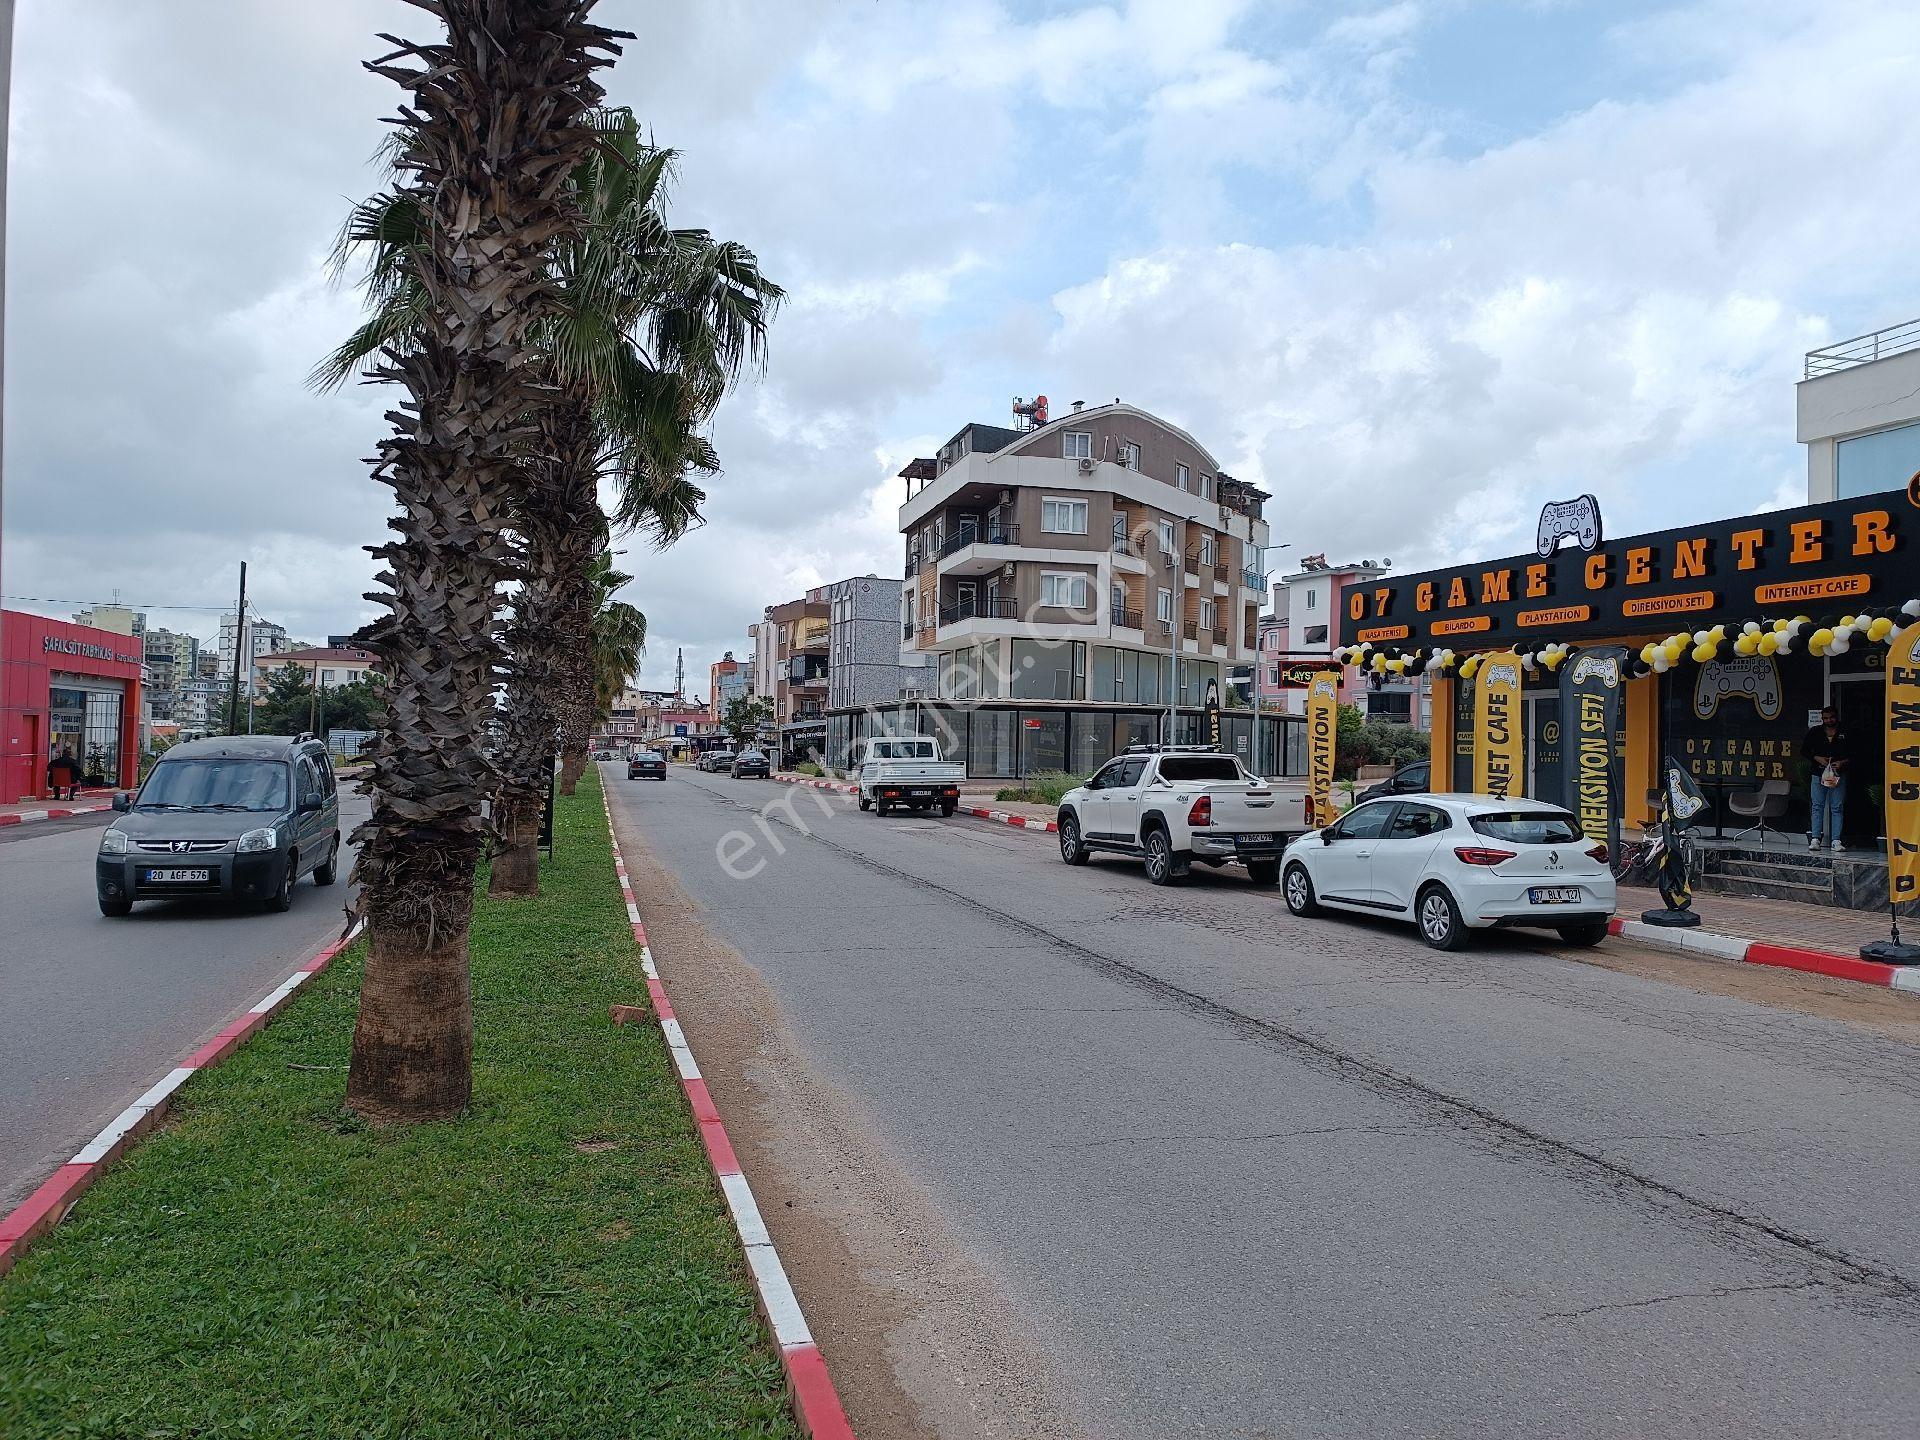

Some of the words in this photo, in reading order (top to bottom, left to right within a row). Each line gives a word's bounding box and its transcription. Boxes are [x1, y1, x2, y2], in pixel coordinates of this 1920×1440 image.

[1416, 563, 1547, 612] GAME
[1584, 510, 1896, 590] CENTER
[1826, 579, 1859, 593] CAFE
[1487, 693, 1510, 745] CAFE
[1890, 666, 1920, 801] GAME
[1727, 739, 1791, 757] GAME
[1692, 759, 1784, 778] CENTER
[152, 870, 164, 880] 20
[170, 870, 187, 880] AGF
[190, 870, 207, 880] 576
